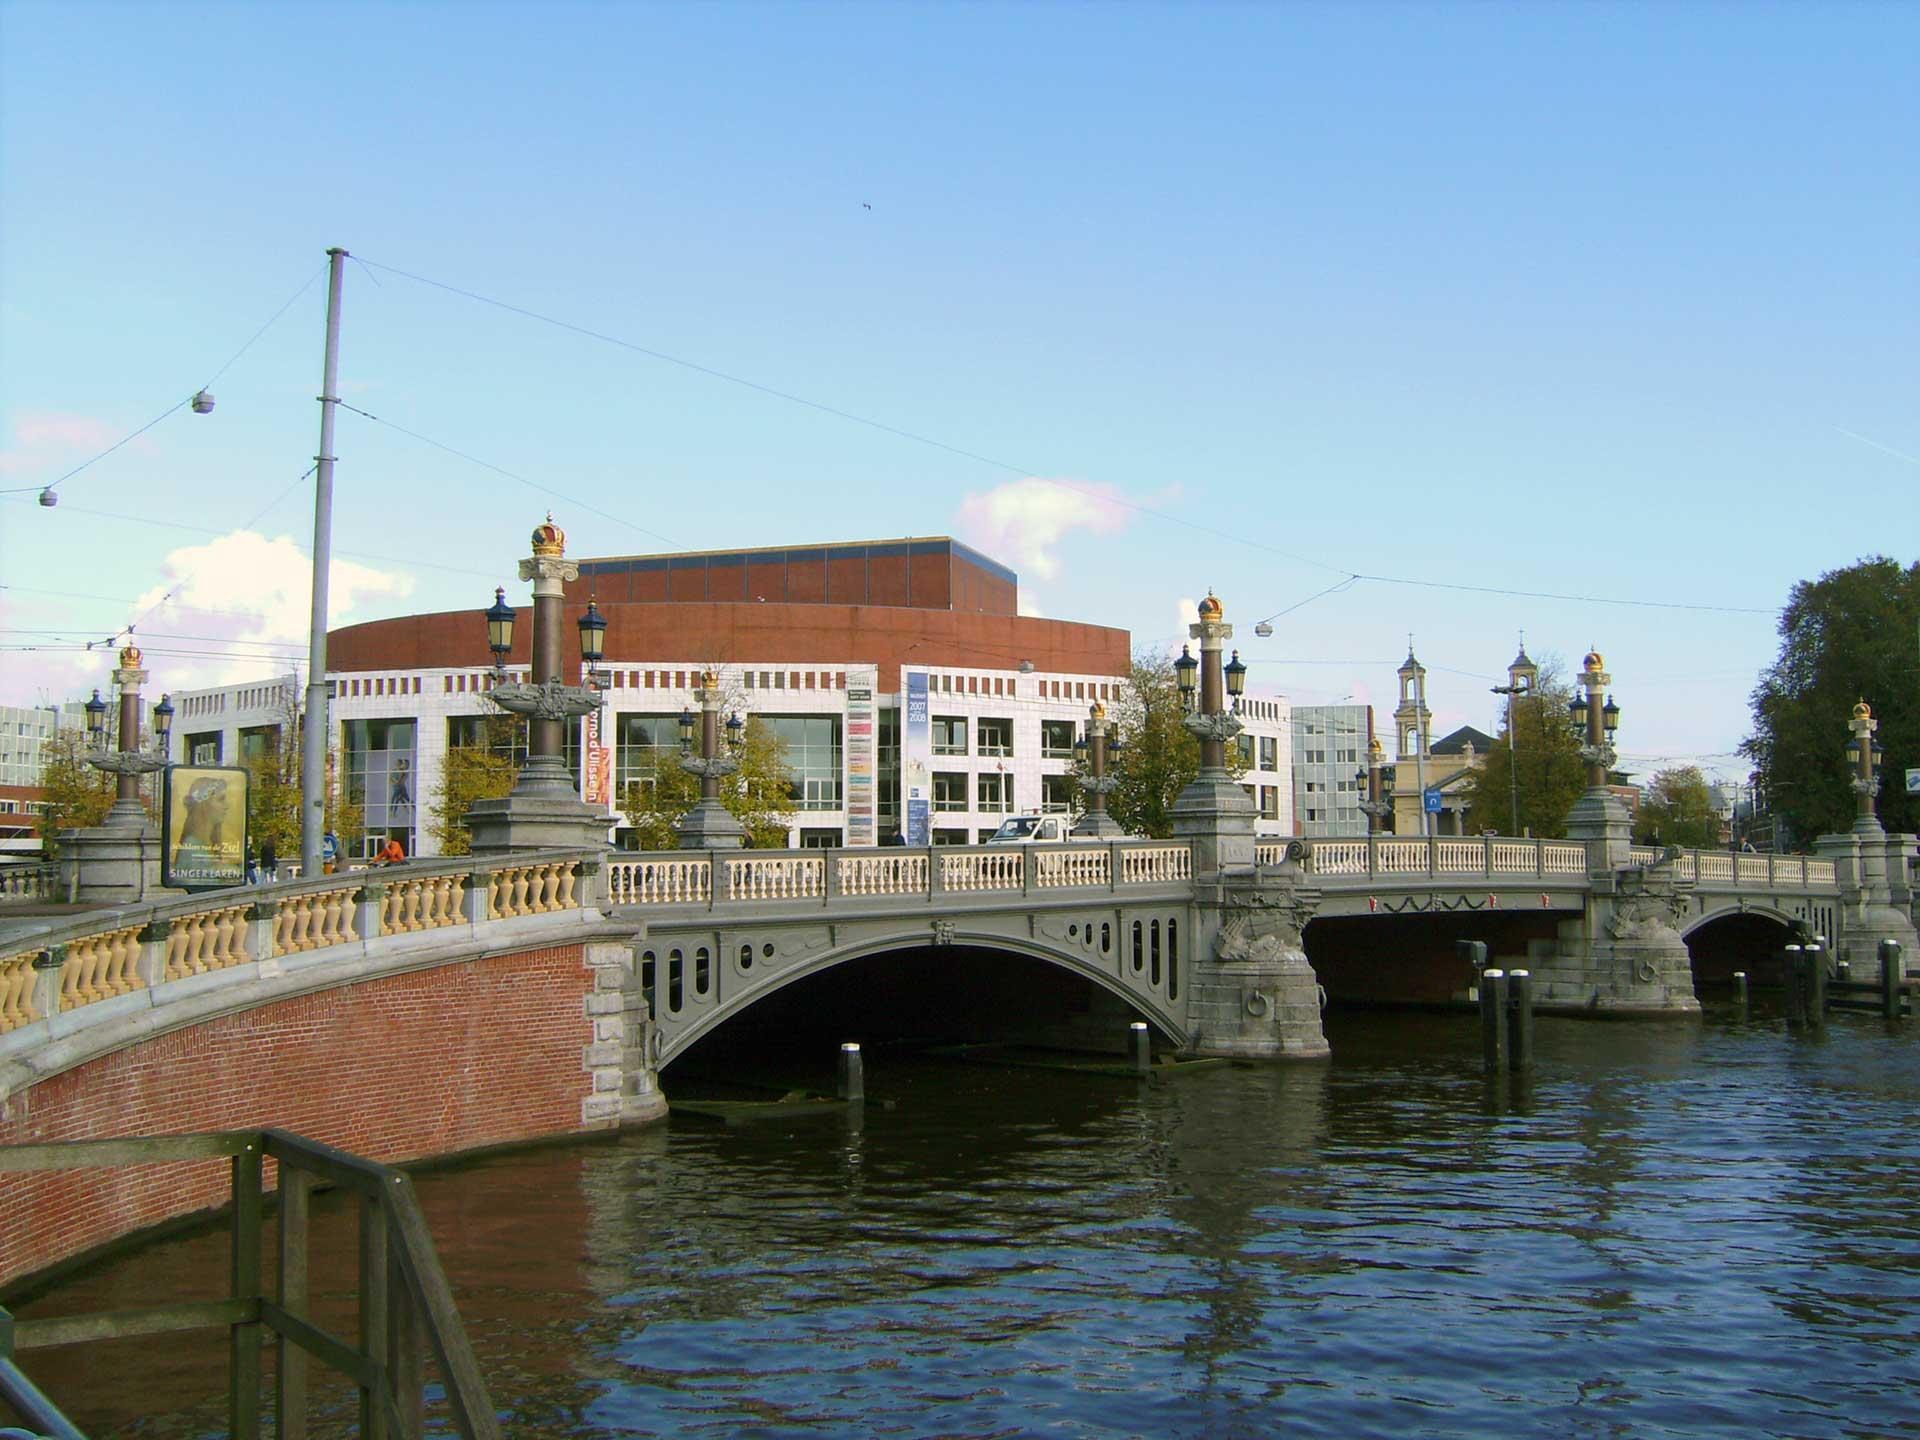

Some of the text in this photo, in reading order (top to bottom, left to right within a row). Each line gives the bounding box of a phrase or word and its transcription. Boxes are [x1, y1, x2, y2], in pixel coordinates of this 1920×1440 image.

[909, 702, 926, 712] 2007
[169, 868, 240, 879] SINGER LAREN
